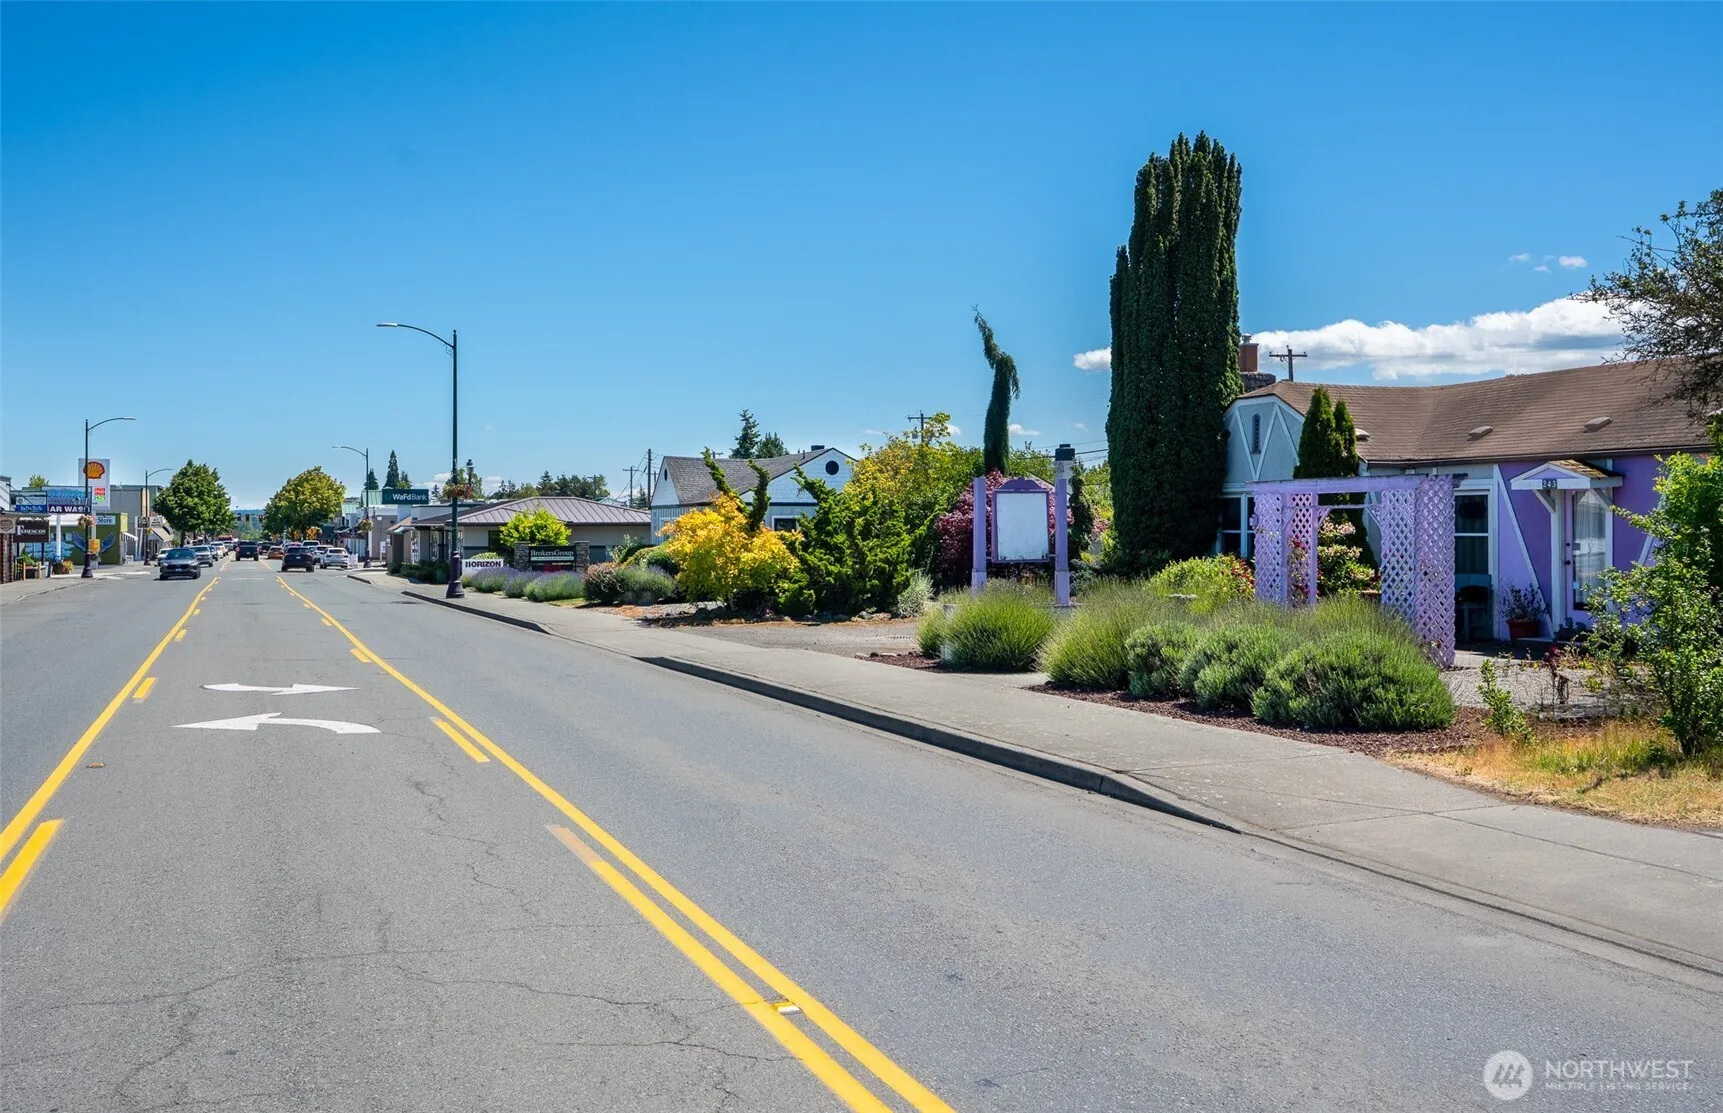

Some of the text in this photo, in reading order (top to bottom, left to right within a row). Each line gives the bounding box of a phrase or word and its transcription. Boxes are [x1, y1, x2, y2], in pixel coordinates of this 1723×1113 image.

[1542, 479, 1557, 489] 243
[48, 505, 63, 513] AR
[97, 516, 113, 524] Store
[465, 560, 502, 568] HORIZON
